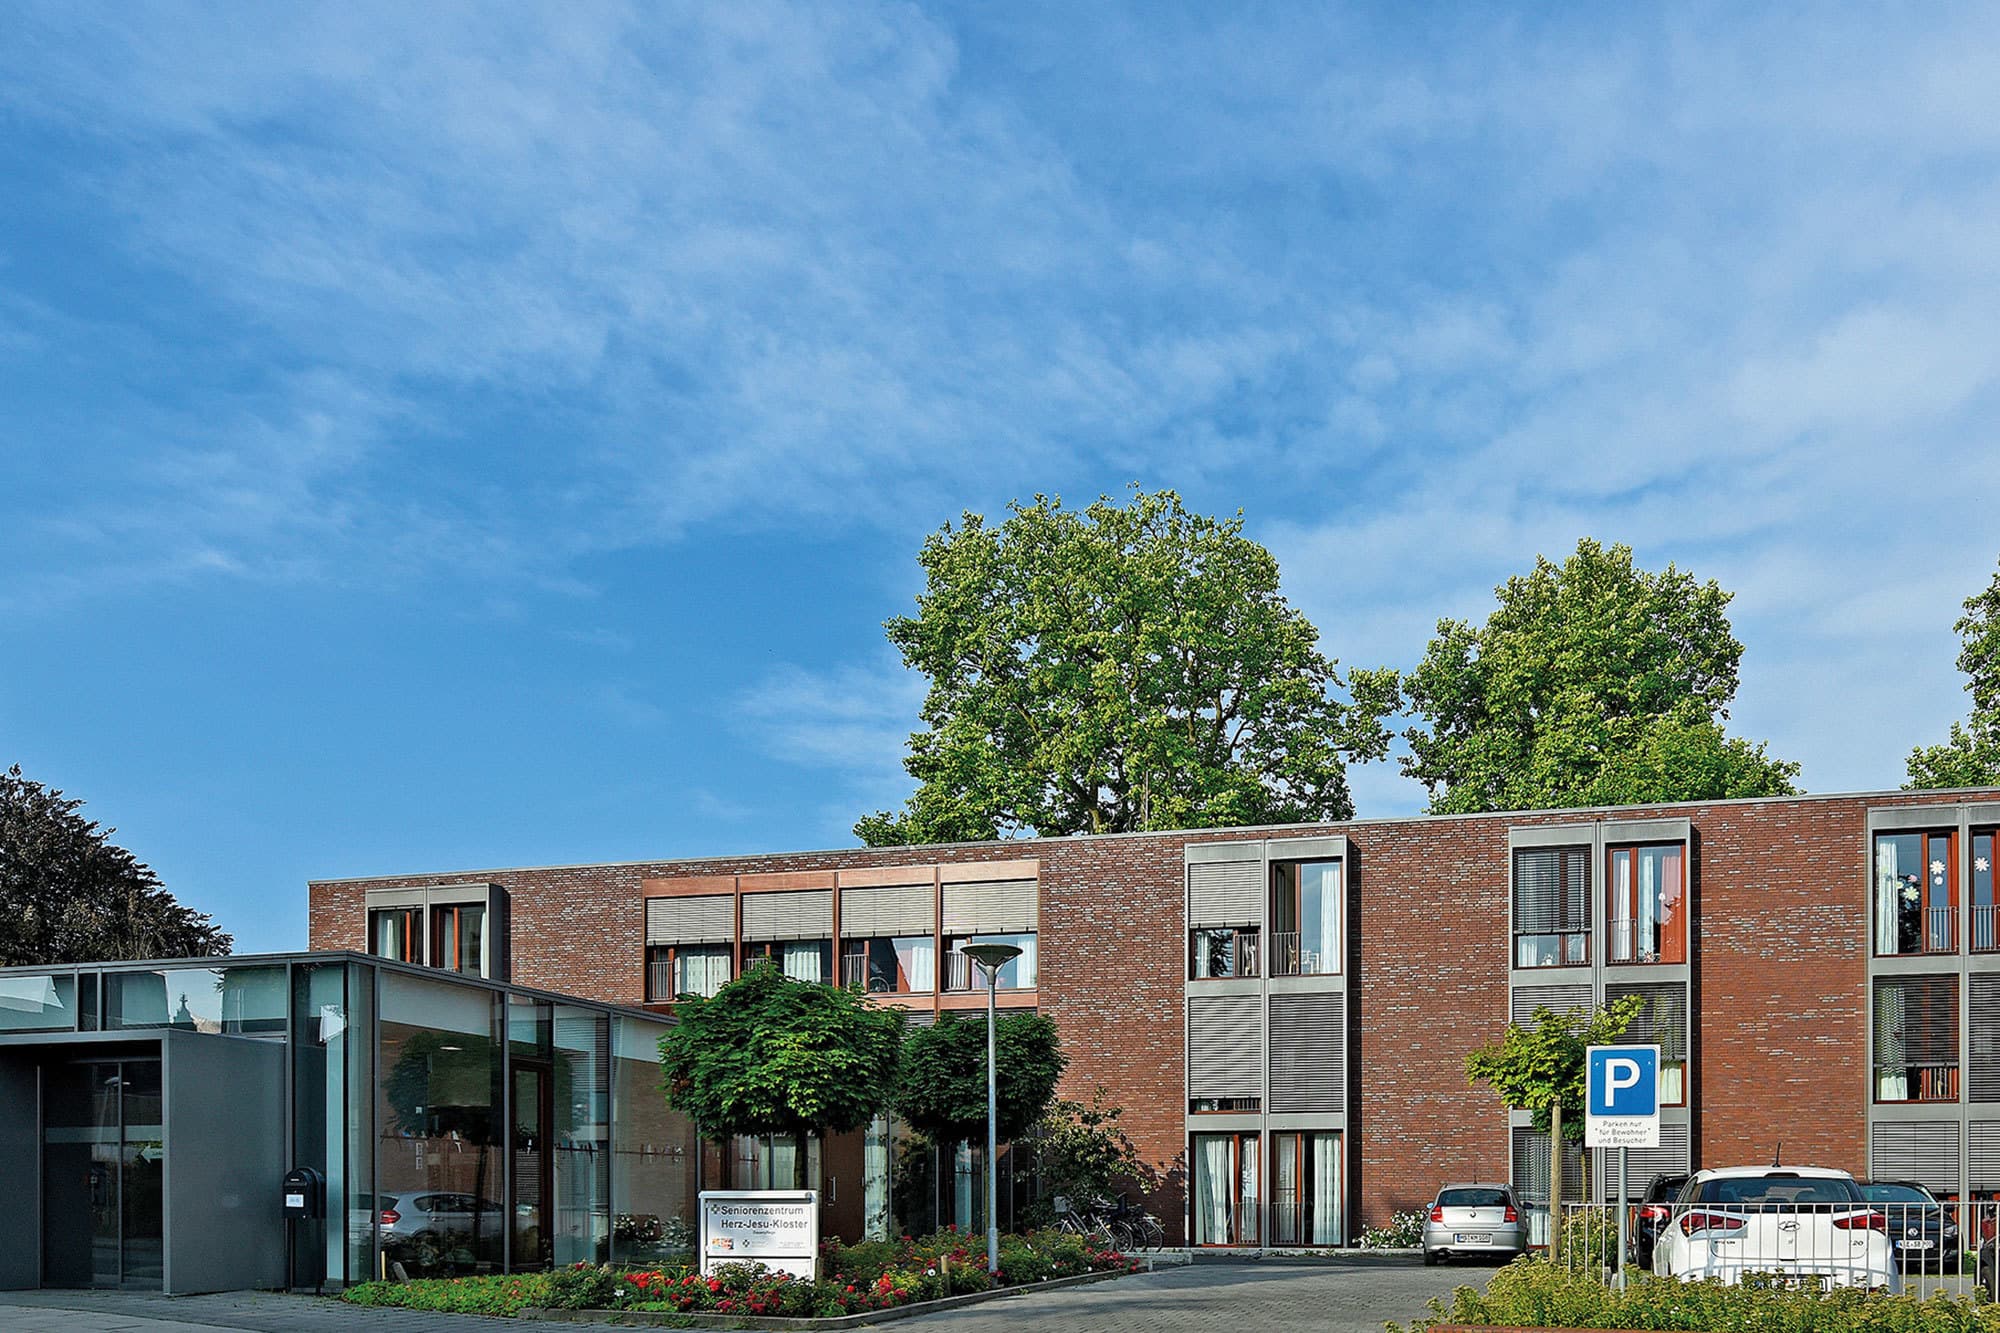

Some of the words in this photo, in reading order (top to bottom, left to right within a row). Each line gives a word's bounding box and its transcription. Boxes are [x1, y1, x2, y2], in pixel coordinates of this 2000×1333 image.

[1604, 1058, 1640, 1107] P
[1611, 1128, 1647, 1136] Bewohner
[721, 1205, 804, 1216] Seniorenzentrum
[721, 1219, 808, 1229] Herz-Jesu-Kloster
